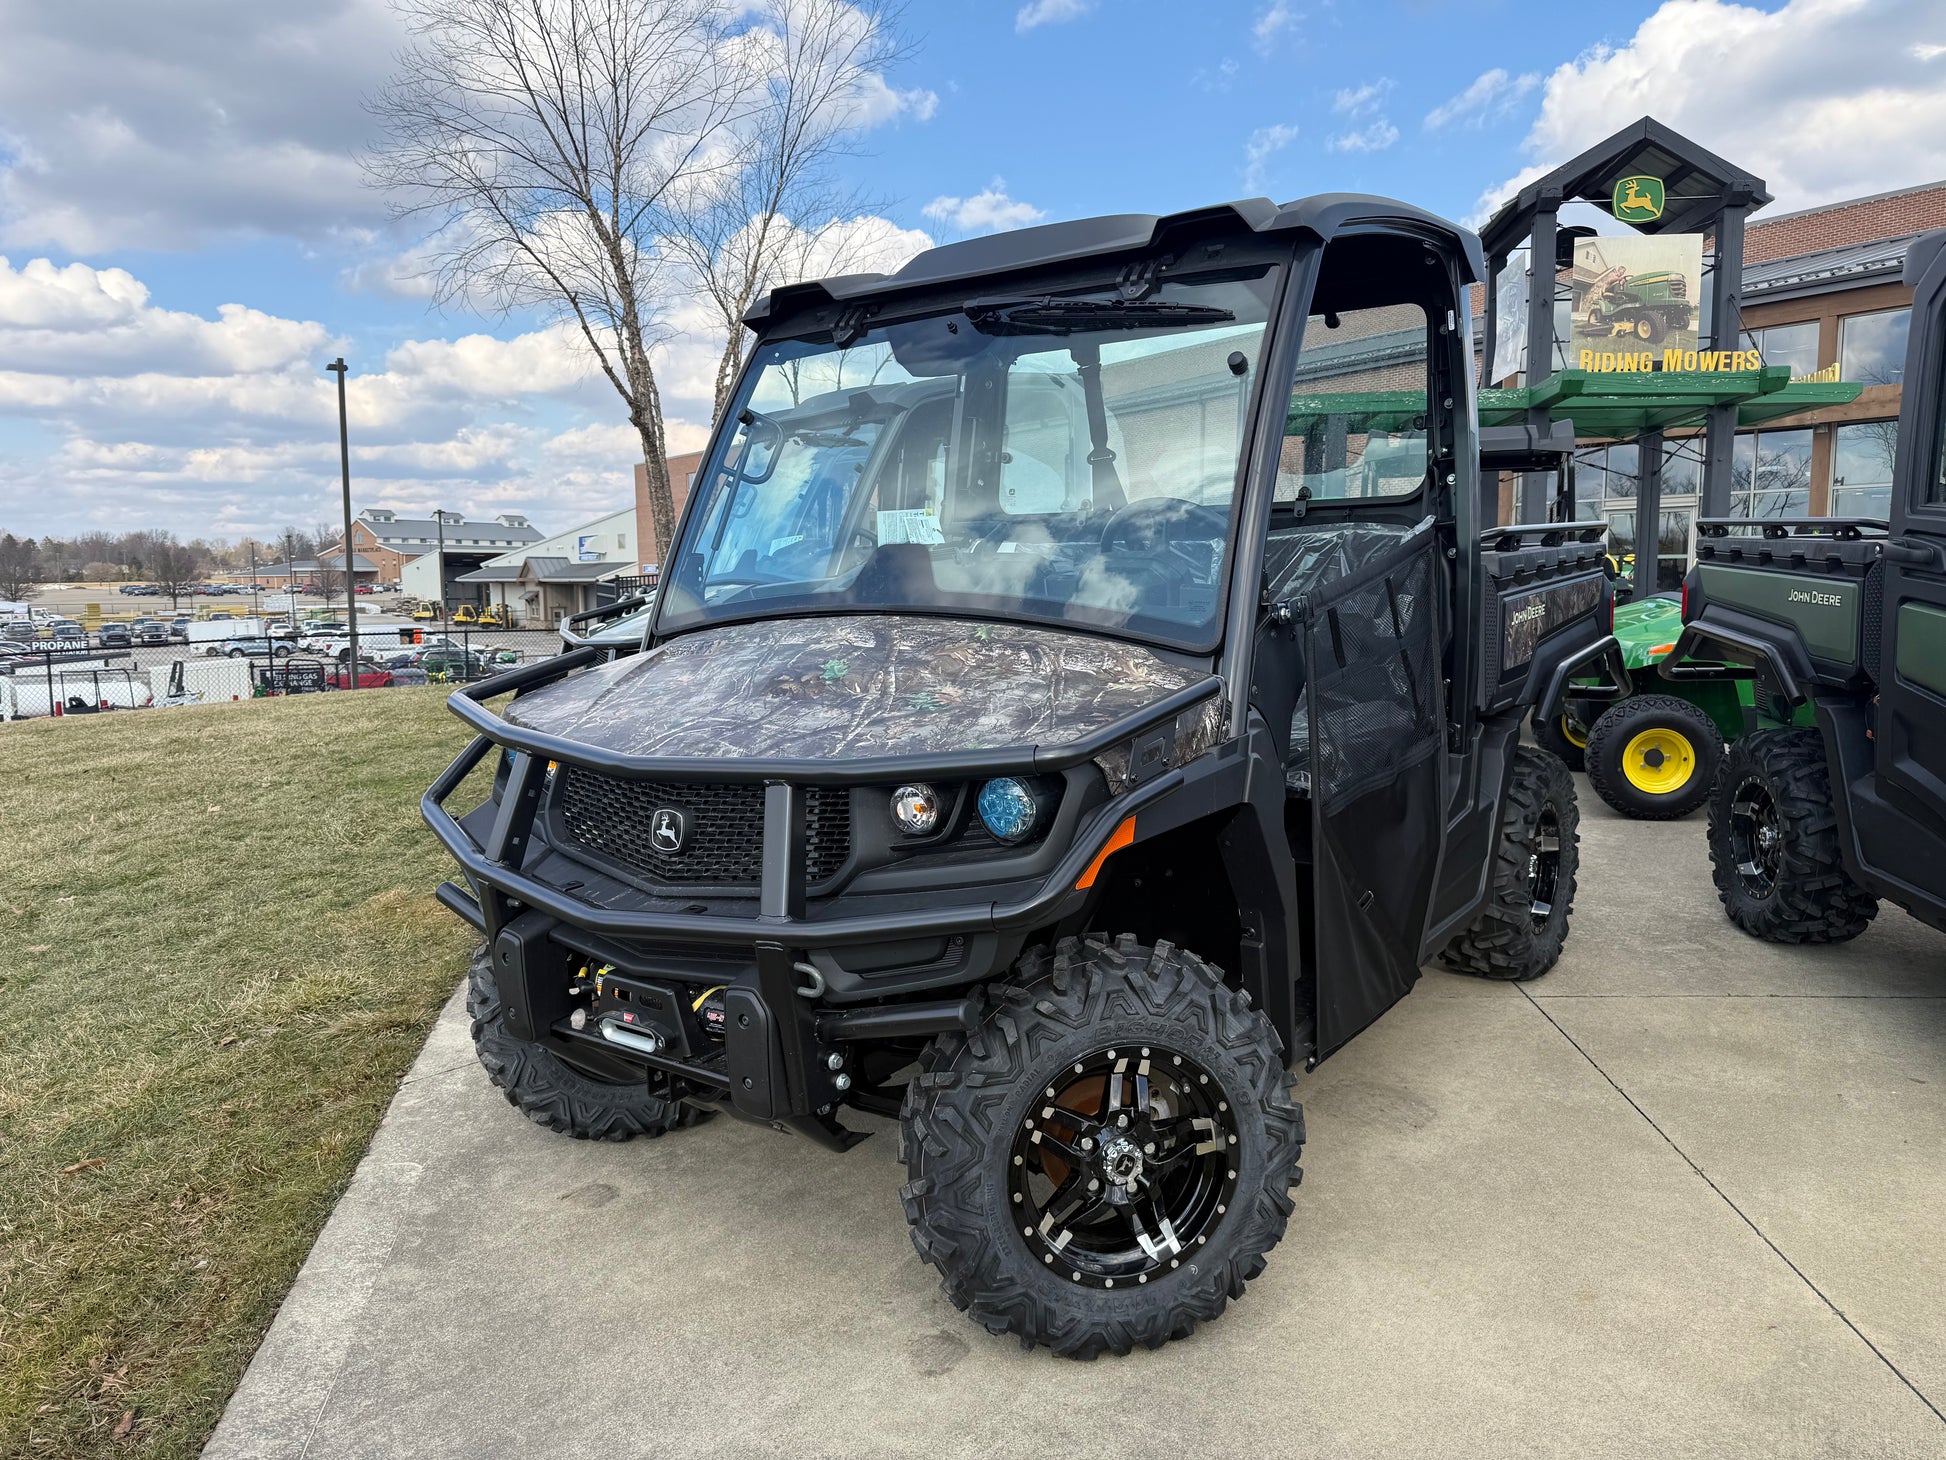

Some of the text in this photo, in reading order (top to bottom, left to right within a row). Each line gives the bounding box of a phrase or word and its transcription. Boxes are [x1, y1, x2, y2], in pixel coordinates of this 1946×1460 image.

[1579, 348, 1760, 373] RIDING MOWERS
[1787, 588, 1842, 607] JOHN DEERE
[1511, 603, 1546, 626] JOHN DEERE
[31, 641, 88, 651] PROPANE
[1095, 1021, 1221, 1059] BIGHORN
[1015, 1068, 1041, 1098] RADIAL
